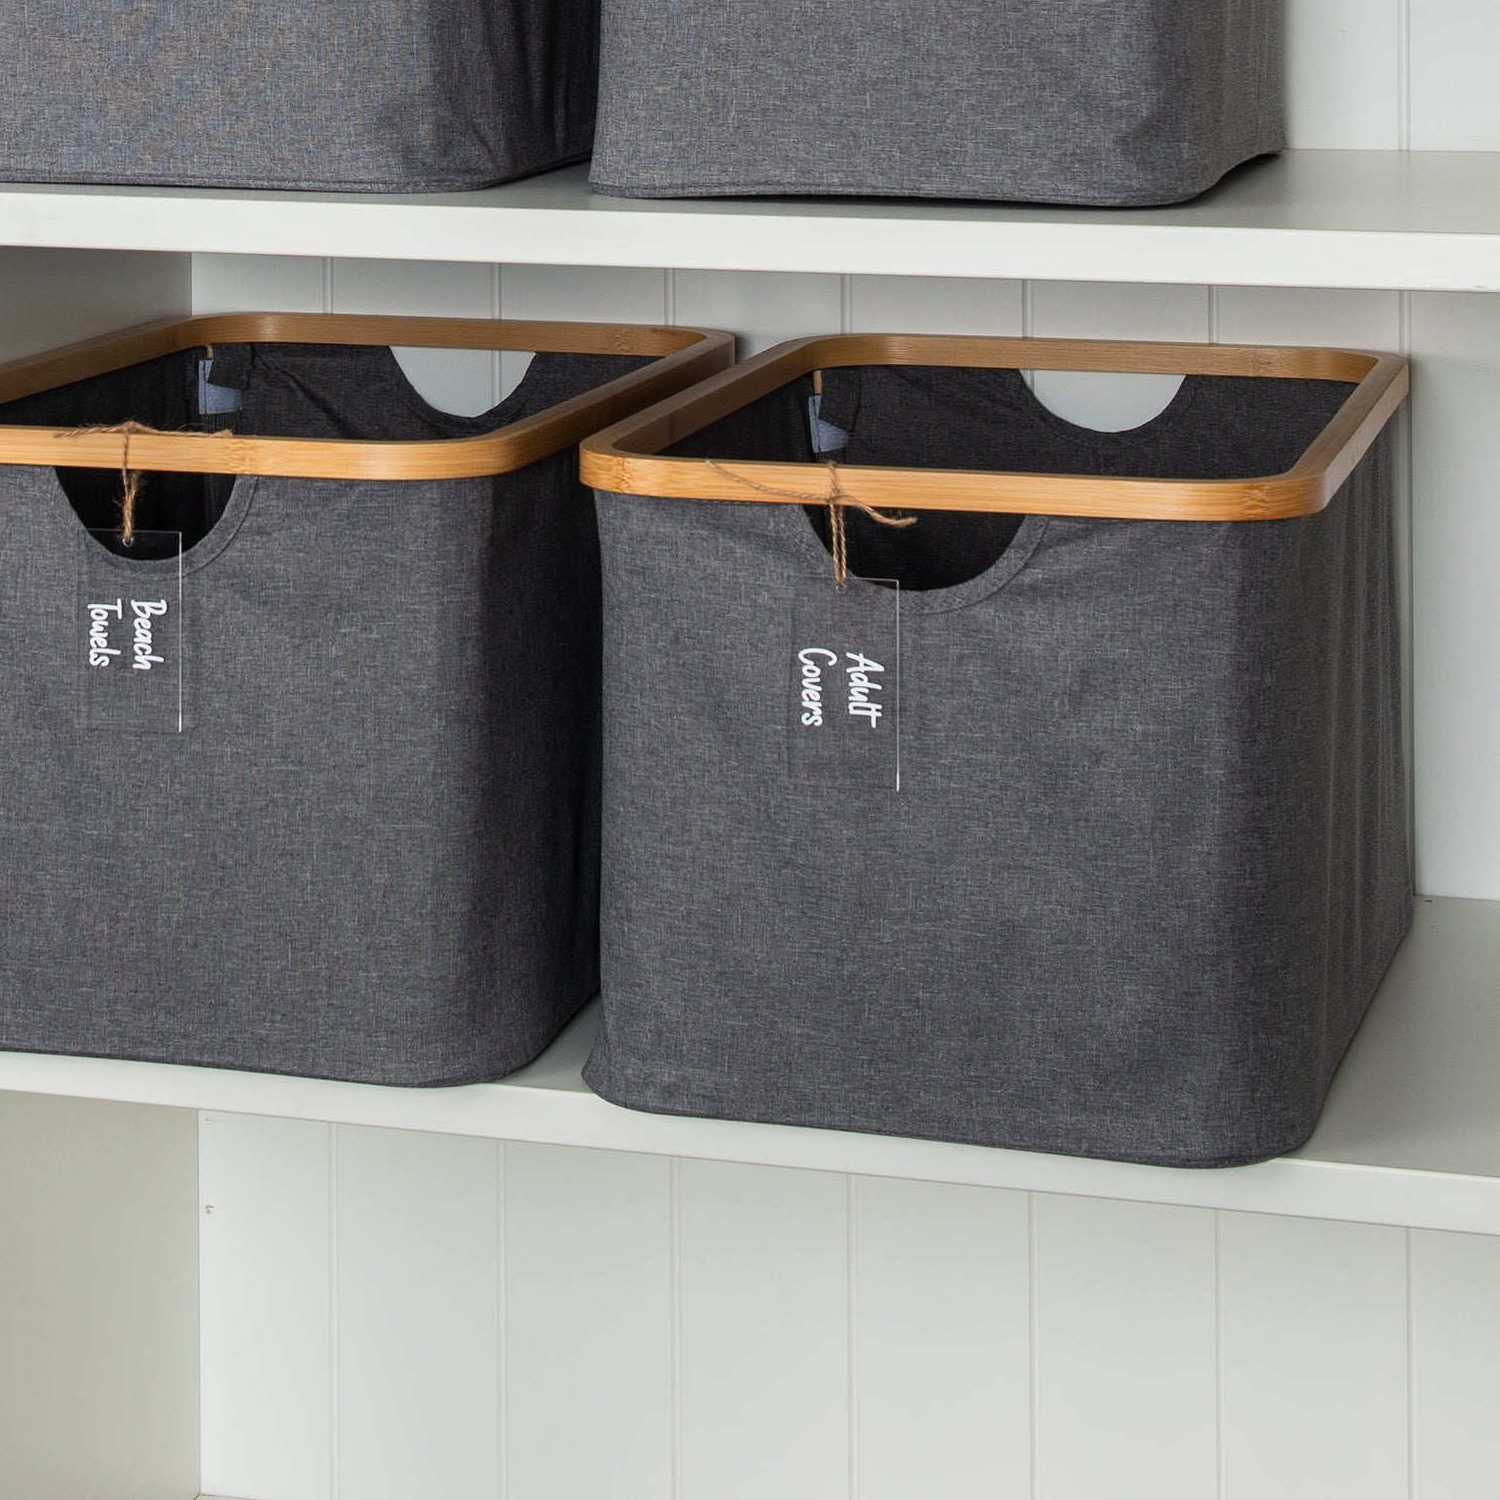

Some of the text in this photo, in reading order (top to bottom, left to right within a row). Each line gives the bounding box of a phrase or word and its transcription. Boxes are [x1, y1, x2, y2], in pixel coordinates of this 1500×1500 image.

[87, 597, 123, 667] Towels
[130, 599, 167, 670] Beach
[798, 647, 838, 727] Covers
[845, 652, 885, 729] Adult
